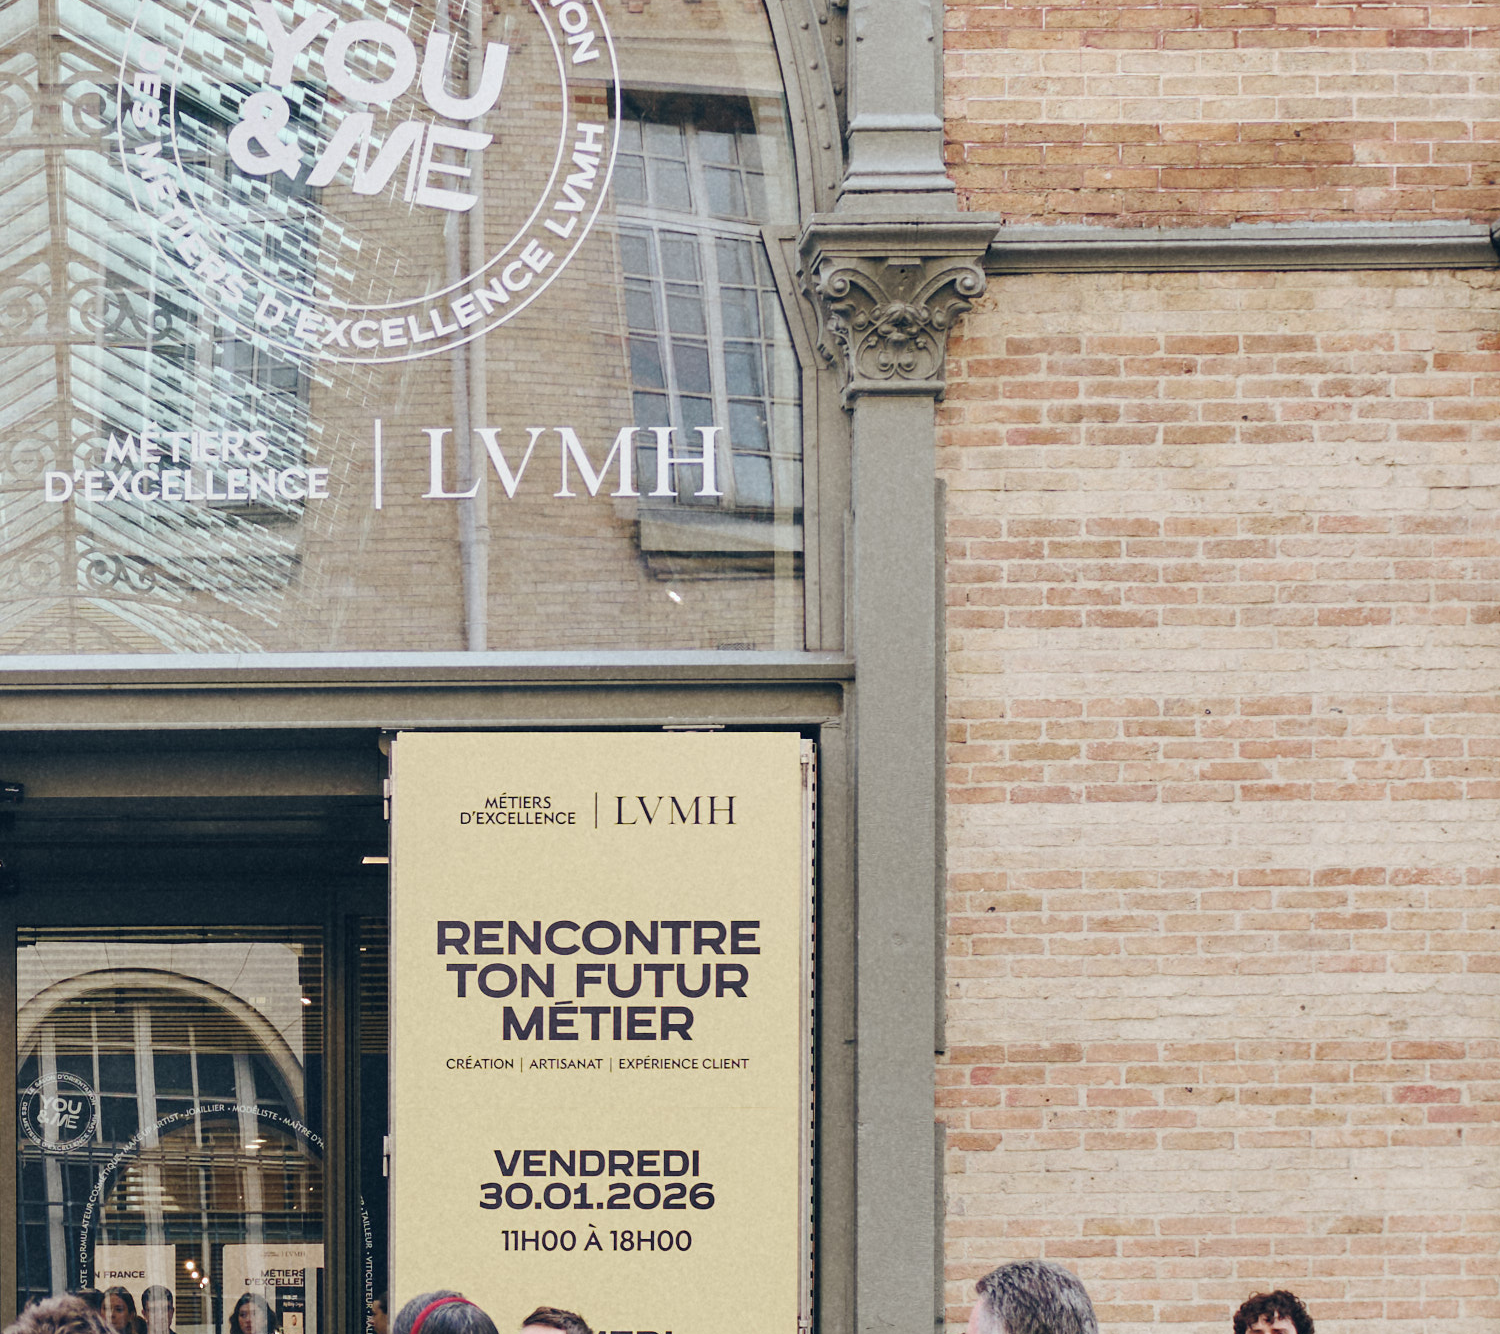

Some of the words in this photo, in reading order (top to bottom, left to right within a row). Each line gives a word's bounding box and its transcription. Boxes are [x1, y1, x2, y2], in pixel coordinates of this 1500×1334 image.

[251, 0, 509, 121] YOU
[132, 41, 168, 128] DES
[254, 239, 554, 349] D'EXCELLENCE
[545, 121, 605, 239] LVMH
[104, 421, 268, 464] MÉTIERS
[422, 426, 724, 498] LVMH
[45, 467, 329, 502] D'EXCELLENCE
[485, 793, 551, 808] MÉTIERS
[616, 796, 735, 824] LVMH
[459, 810, 576, 825] D'EXCELLENCE
[437, 920, 760, 955] RENCONTRE
[447, 963, 554, 998] TON
[577, 964, 748, 998] FUTUR
[503, 1001, 694, 1040] MÉTIER
[447, 1056, 513, 1069] CRÉATION
[530, 1059, 603, 1069] ARTISANAT
[619, 1056, 698, 1069] EXPÉRIENCE
[703, 1059, 749, 1069] CLIENT
[41, 1095, 82, 1114] YOU
[494, 1150, 699, 1176] VENDREDI
[79, 1201, 94, 1263] FORMULATEUR
[152, 1113, 179, 1130] ARTIST
[184, 1104, 225, 1117] JOAILLIER
[232, 1105, 278, 1120] MODÉLISTE
[282, 1117, 311, 1137] MAÎTRE
[480, 1183, 715, 1209] 30.01.2026
[361, 1210, 373, 1249] TAILLEUR
[502, 1230, 576, 1251] 11H00
[584, 1224, 603, 1251] À
[610, 1230, 691, 1251] 18H00
[104, 1271, 145, 1279] FRANCE
[245, 1278, 305, 1286] D'EXCELLEN
